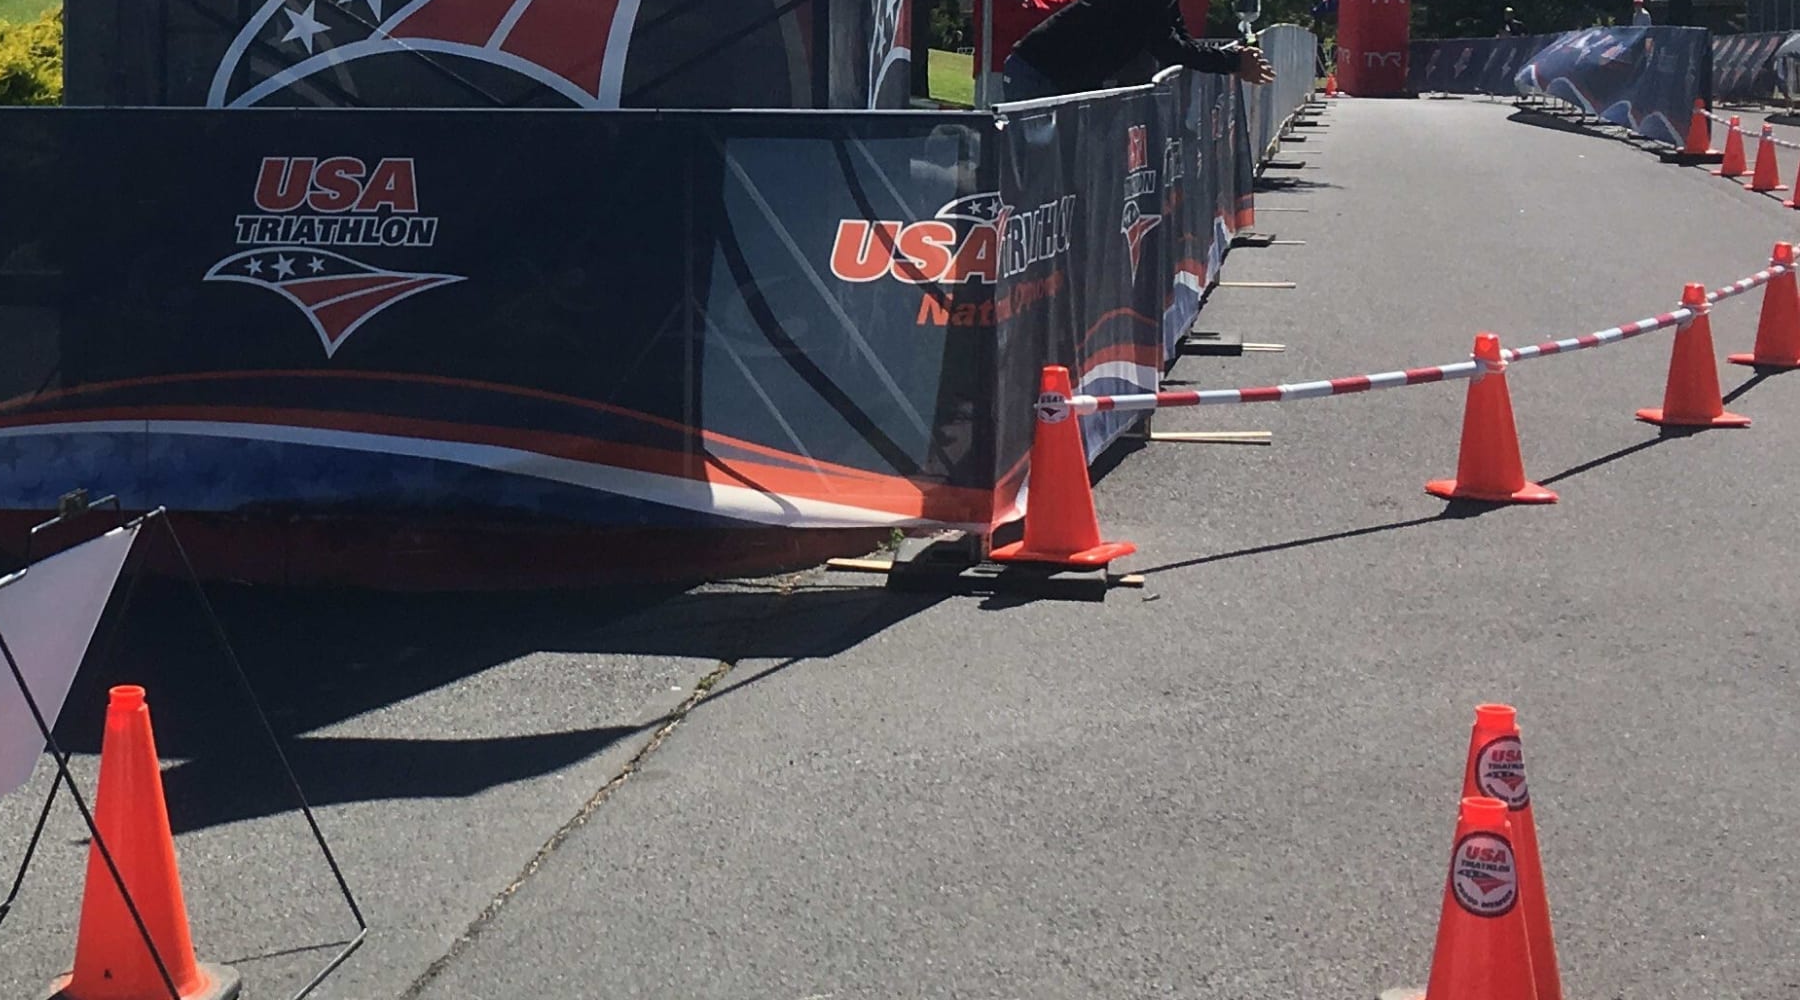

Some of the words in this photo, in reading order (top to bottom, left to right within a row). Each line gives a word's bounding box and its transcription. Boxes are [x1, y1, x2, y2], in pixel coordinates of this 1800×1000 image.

[1363, 51, 1401, 67] TYR
[253, 156, 419, 213] USA
[235, 215, 439, 247] TRIATHLON
[829, 218, 1000, 285] USA
[1460, 859, 1511, 873] TRIATHLON
[1465, 845, 1507, 864] USA
